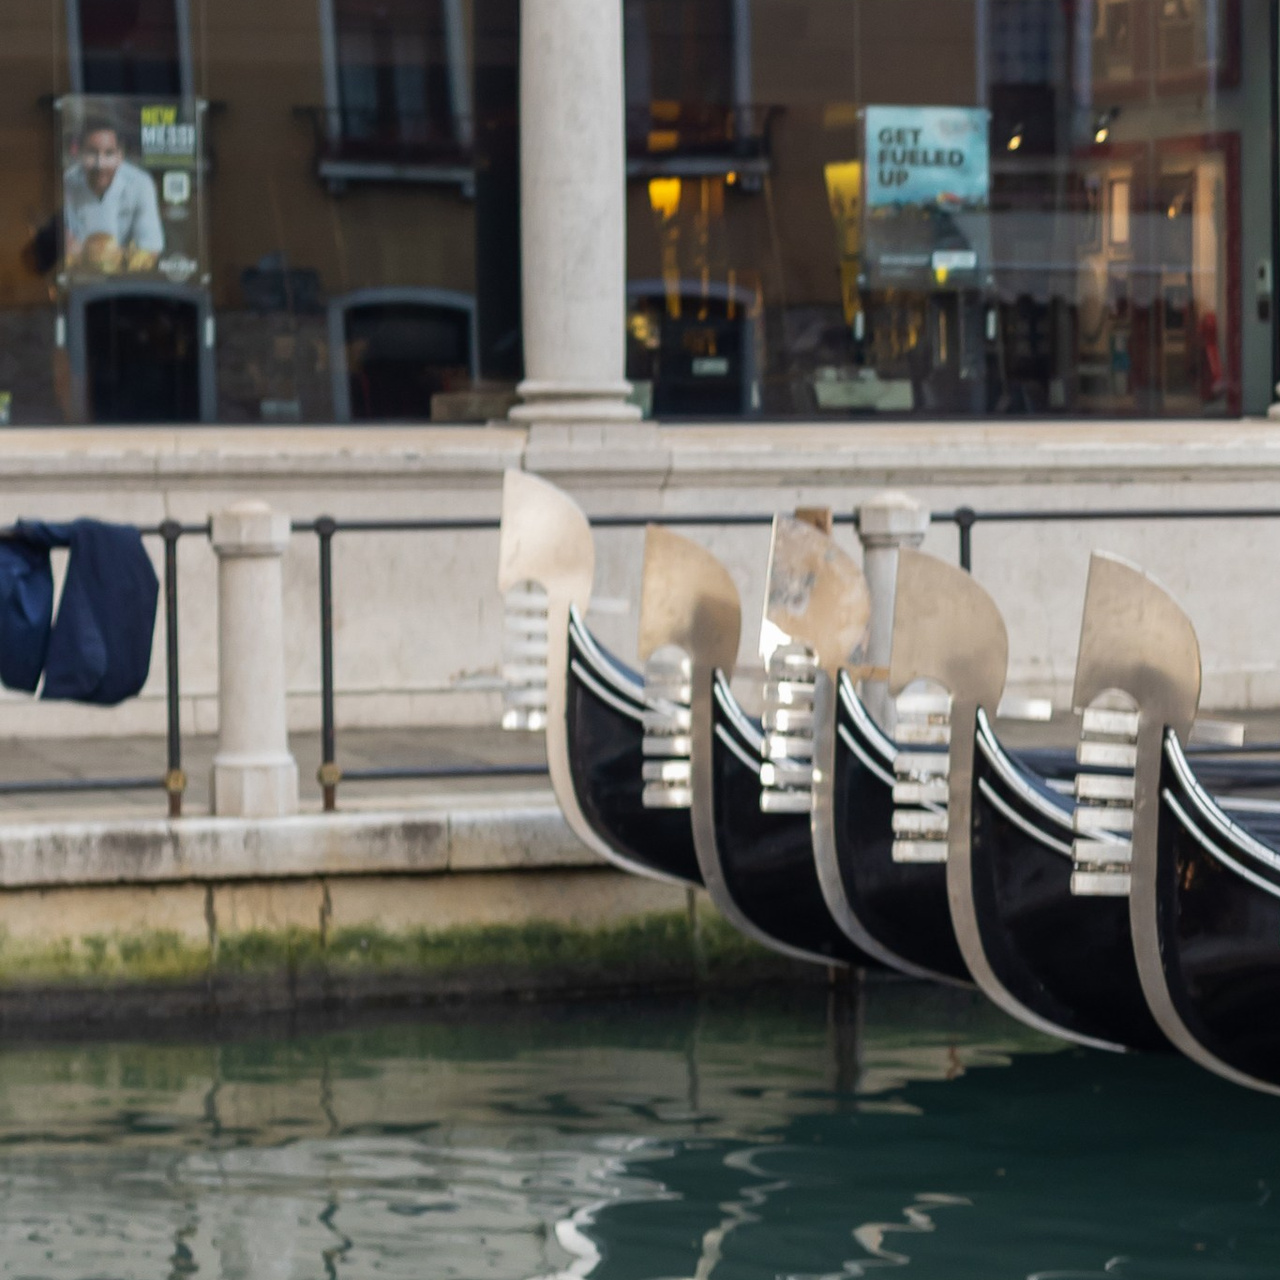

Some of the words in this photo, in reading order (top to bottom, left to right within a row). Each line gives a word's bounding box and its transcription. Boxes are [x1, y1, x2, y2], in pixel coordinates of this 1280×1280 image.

[878, 127, 922, 146] GET
[878, 149, 965, 167] FUELED
[878, 170, 909, 187] UP
